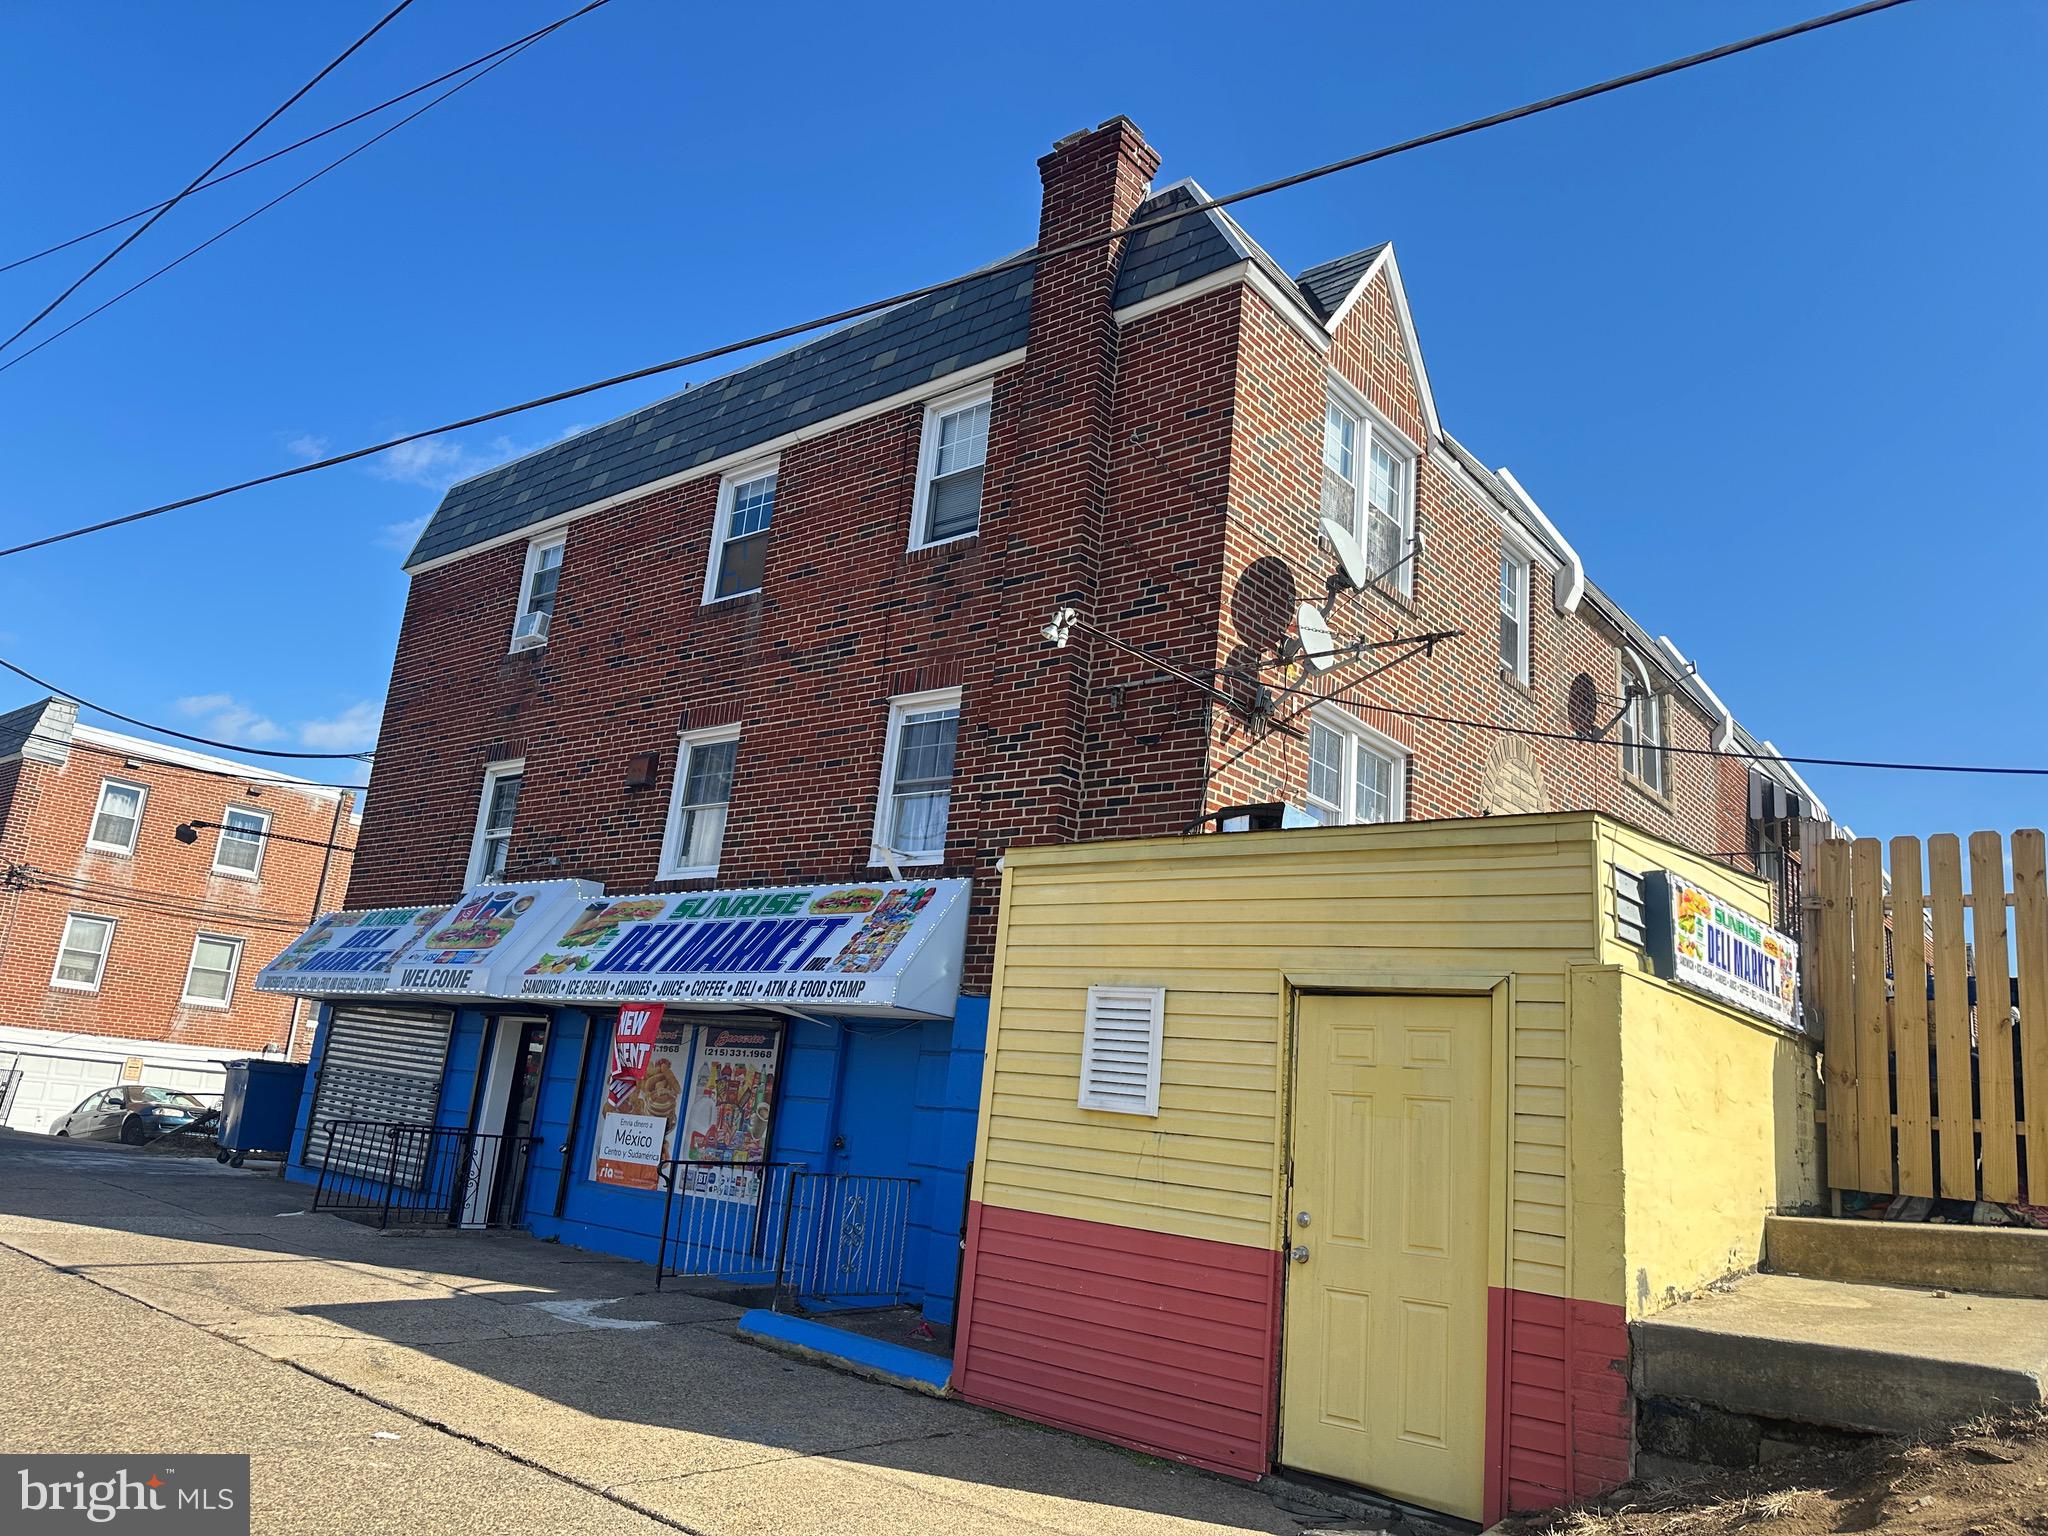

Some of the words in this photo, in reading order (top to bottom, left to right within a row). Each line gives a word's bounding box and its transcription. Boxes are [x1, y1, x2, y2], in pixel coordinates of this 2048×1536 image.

[666, 890, 813, 920] SUNRISE
[357, 908, 421, 927] SUNRISE
[1714, 907, 1761, 946] SUNRISE
[338, 928, 400, 949] DELI
[588, 922, 697, 974] DELI
[656, 916, 853, 974] MARKET
[296, 951, 394, 972] MARKET
[802, 957, 832, 972] INC.
[1708, 924, 1731, 973] DELI
[1734, 939, 1776, 995] MARKET
[400, 969, 473, 989] WELCOME
[521, 979, 562, 995] SANDWICH
[565, 980, 581, 994] ICE
[581, 980, 610, 996] CREAM
[614, 980, 652, 996] CANDIES
[657, 980, 685, 997] JUICE
[690, 980, 728, 997] COFFEE
[732, 980, 757, 997] DELI
[763, 980, 790, 998] ATM
[787, 980, 798, 998] &
[797, 980, 828, 998] FOOD
[826, 980, 866, 998] STAMP
[618, 1011, 651, 1036] NEW
[704, 1048, 772, 1058] (215)331.1968
[633, 1119, 649, 1128] dinero
[614, 1128, 653, 1148] México
[603, 1146, 622, 1157] Centro
[622, 1150, 627, 1158] y
[627, 1149, 660, 1161] Sudamérica
